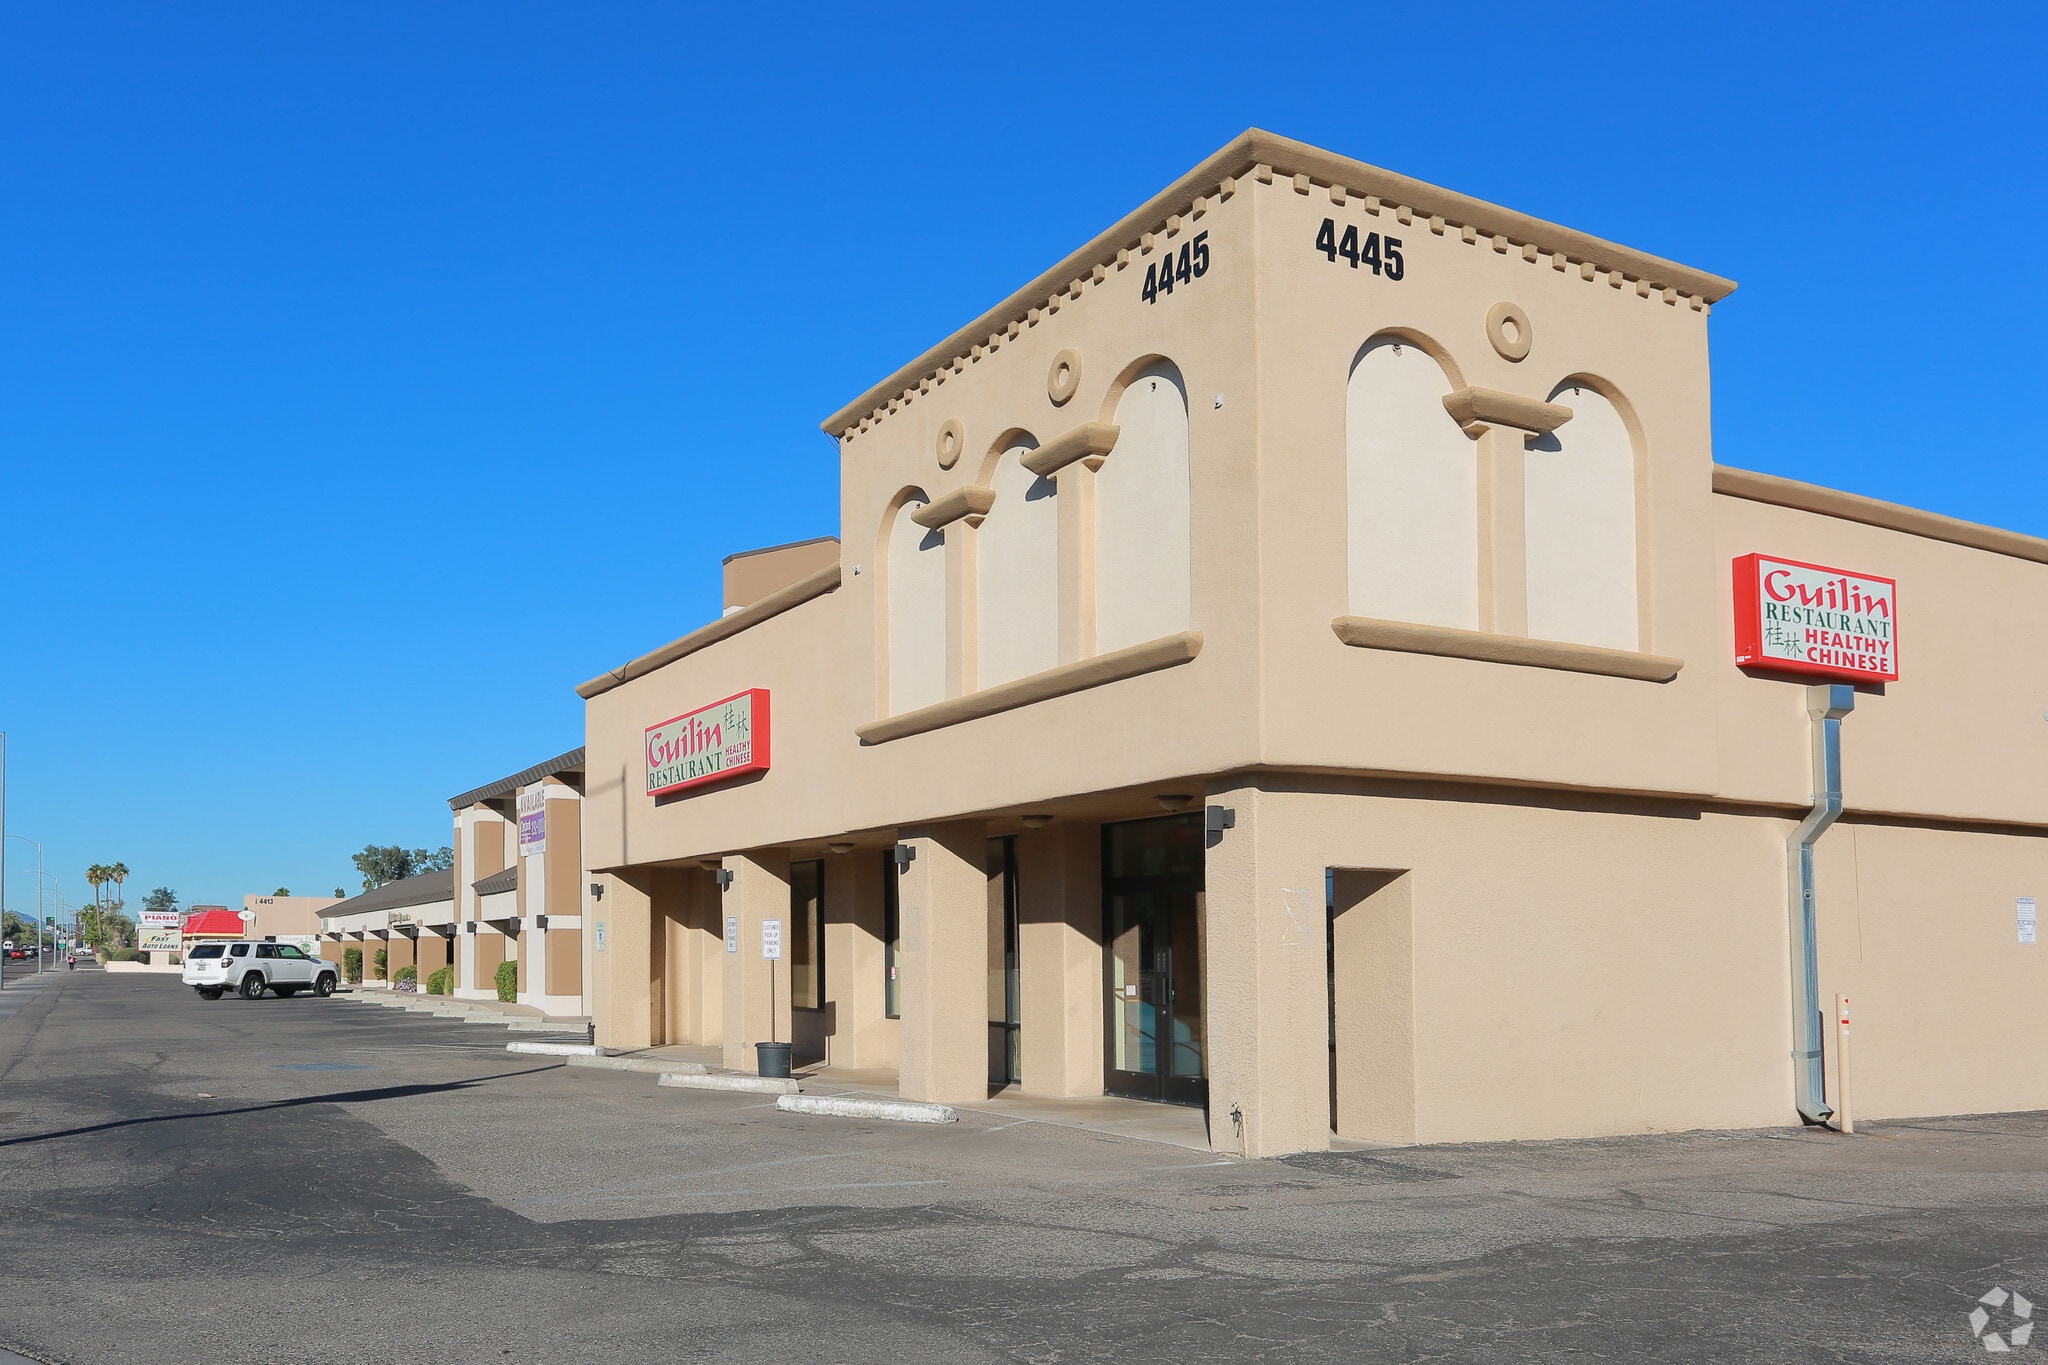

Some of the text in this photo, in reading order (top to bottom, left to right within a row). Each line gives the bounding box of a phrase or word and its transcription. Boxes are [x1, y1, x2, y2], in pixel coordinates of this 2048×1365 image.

[1142, 229, 1210, 305] 4445
[1315, 217, 1404, 281] 4445
[1764, 569, 1889, 619] Guilin
[1765, 602, 1890, 638] RESTAURANT
[1764, 620, 1803, 659] 桂林
[1805, 628, 1890, 655] HEALTHY
[1806, 647, 1889, 673] CHINESE
[723, 703, 749, 740] 桂林
[648, 716, 722, 768] Guilin
[725, 740, 751, 756] HEALTHY
[725, 751, 751, 768] CHINESE
[648, 751, 723, 790] RESTAURANT
